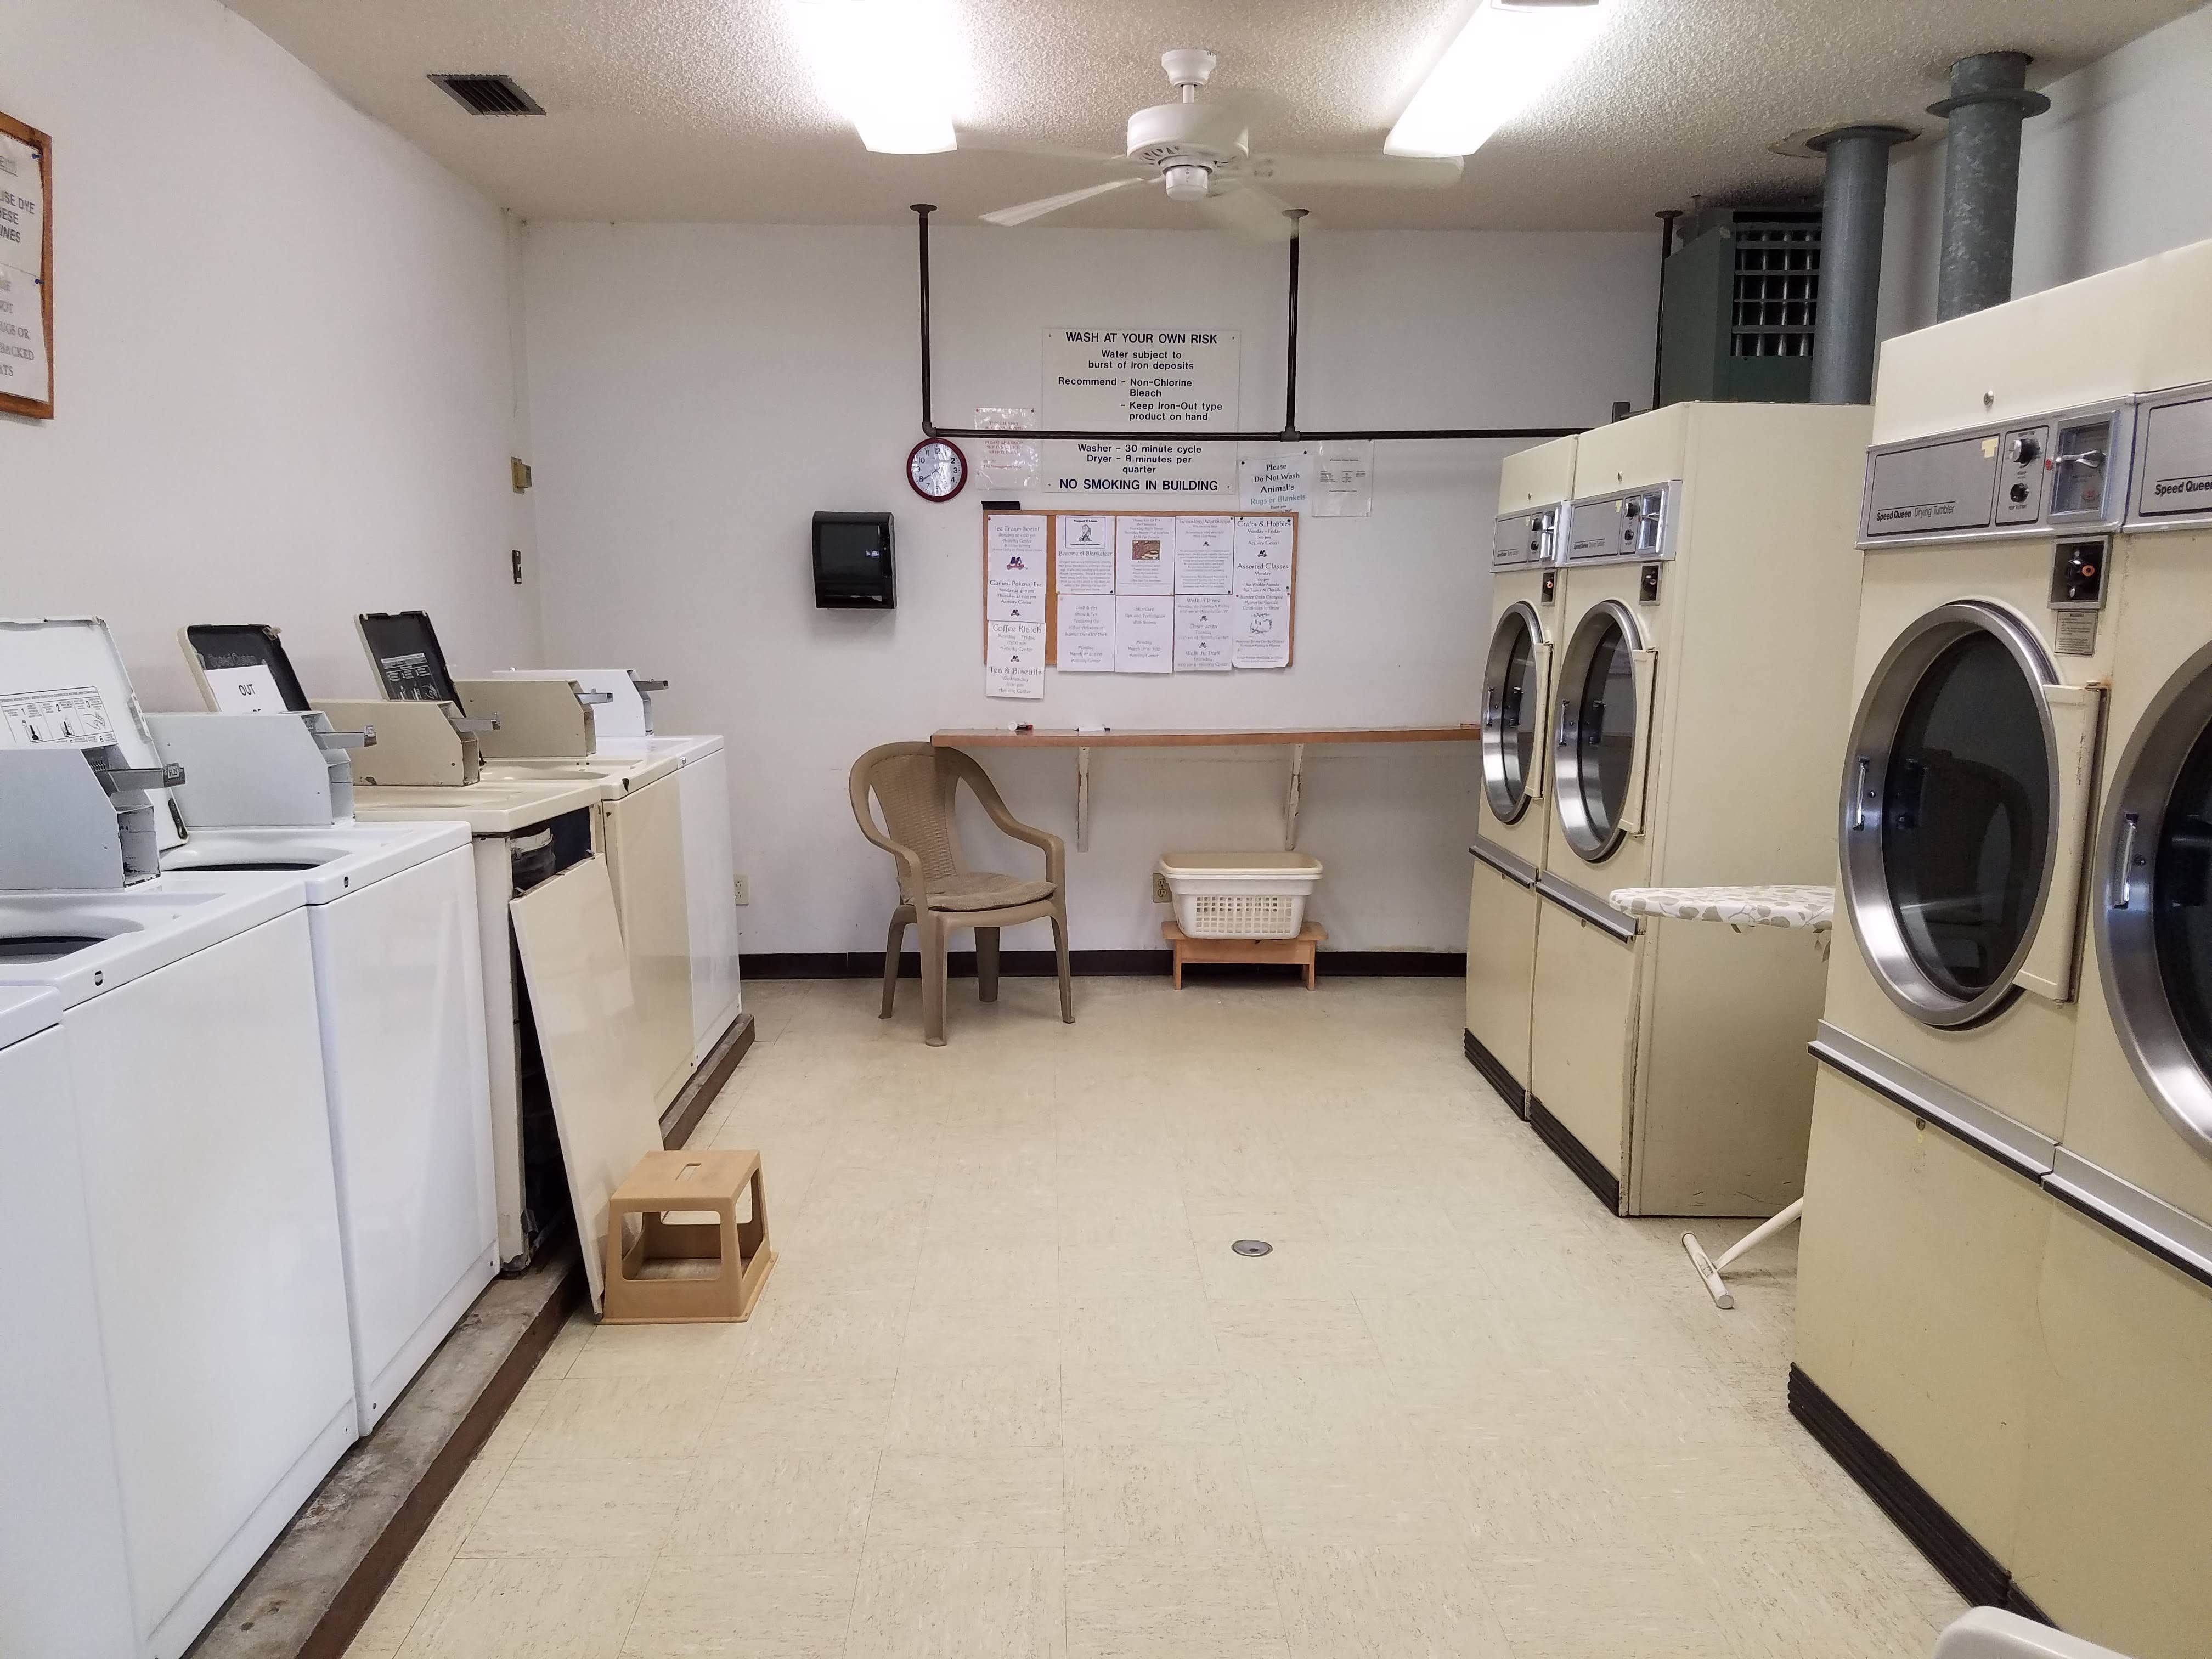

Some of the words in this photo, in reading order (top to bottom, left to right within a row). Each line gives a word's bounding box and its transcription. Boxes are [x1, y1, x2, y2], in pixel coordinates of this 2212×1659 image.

[18, 197, 35, 215] DYE
[1065, 331, 1099, 342] WASH
[1103, 332, 1118, 343] AT
[1122, 332, 1153, 343] YOUR
[1158, 333, 1186, 344] OWN
[1190, 334, 1217, 345] RISK
[1101, 349, 1128, 358] Water
[1132, 350, 1168, 360] subject
[1172, 351, 1182, 359] to
[1088, 360, 1113, 369] burst
[1117, 360, 1127, 369] of
[1131, 360, 1149, 369] iron
[1153, 360, 1194, 371] deposits
[1058, 376, 1117, 386] Recommend
[1130, 377, 1192, 387] Non-Chlorine
[1130, 388, 1161, 397] Bleach
[1130, 401, 1154, 411] Keep
[1158, 401, 1197, 410] Iron-Out
[1201, 402, 1222, 412] type
[1129, 412, 1166, 421] product
[1185, 412, 1208, 421] hand
[1077, 443, 1112, 452] Washer
[1125, 444, 1138, 453] 30
[1142, 445, 1173, 453] minute
[1177, 445, 1201, 455] cycle
[1087, 454, 1112, 464] Dryer
[1136, 455, 1172, 464] minutes
[1176, 457, 1192, 465] per
[1122, 466, 1156, 475] quarter
[1060, 478, 1077, 489] NO
[1083, 479, 1140, 490] SMOKING
[1146, 479, 1157, 490] IN
[1162, 480, 1218, 491] BUILDING
[1260, 483, 1295, 493] Animal's
[2155, 482, 2185, 497] Speed
[1278, 494, 1306, 503] Blankets
[1877, 511, 1893, 522] Speed
[1894, 510, 1911, 519] Queen
[1914, 507, 1932, 518] Drying
[1933, 504, 1955, 515] Tumbler
[993, 624, 1016, 633] Coffee
[1012, 667, 1042, 675] Biscuits
[239, 684, 256, 696] OUT
